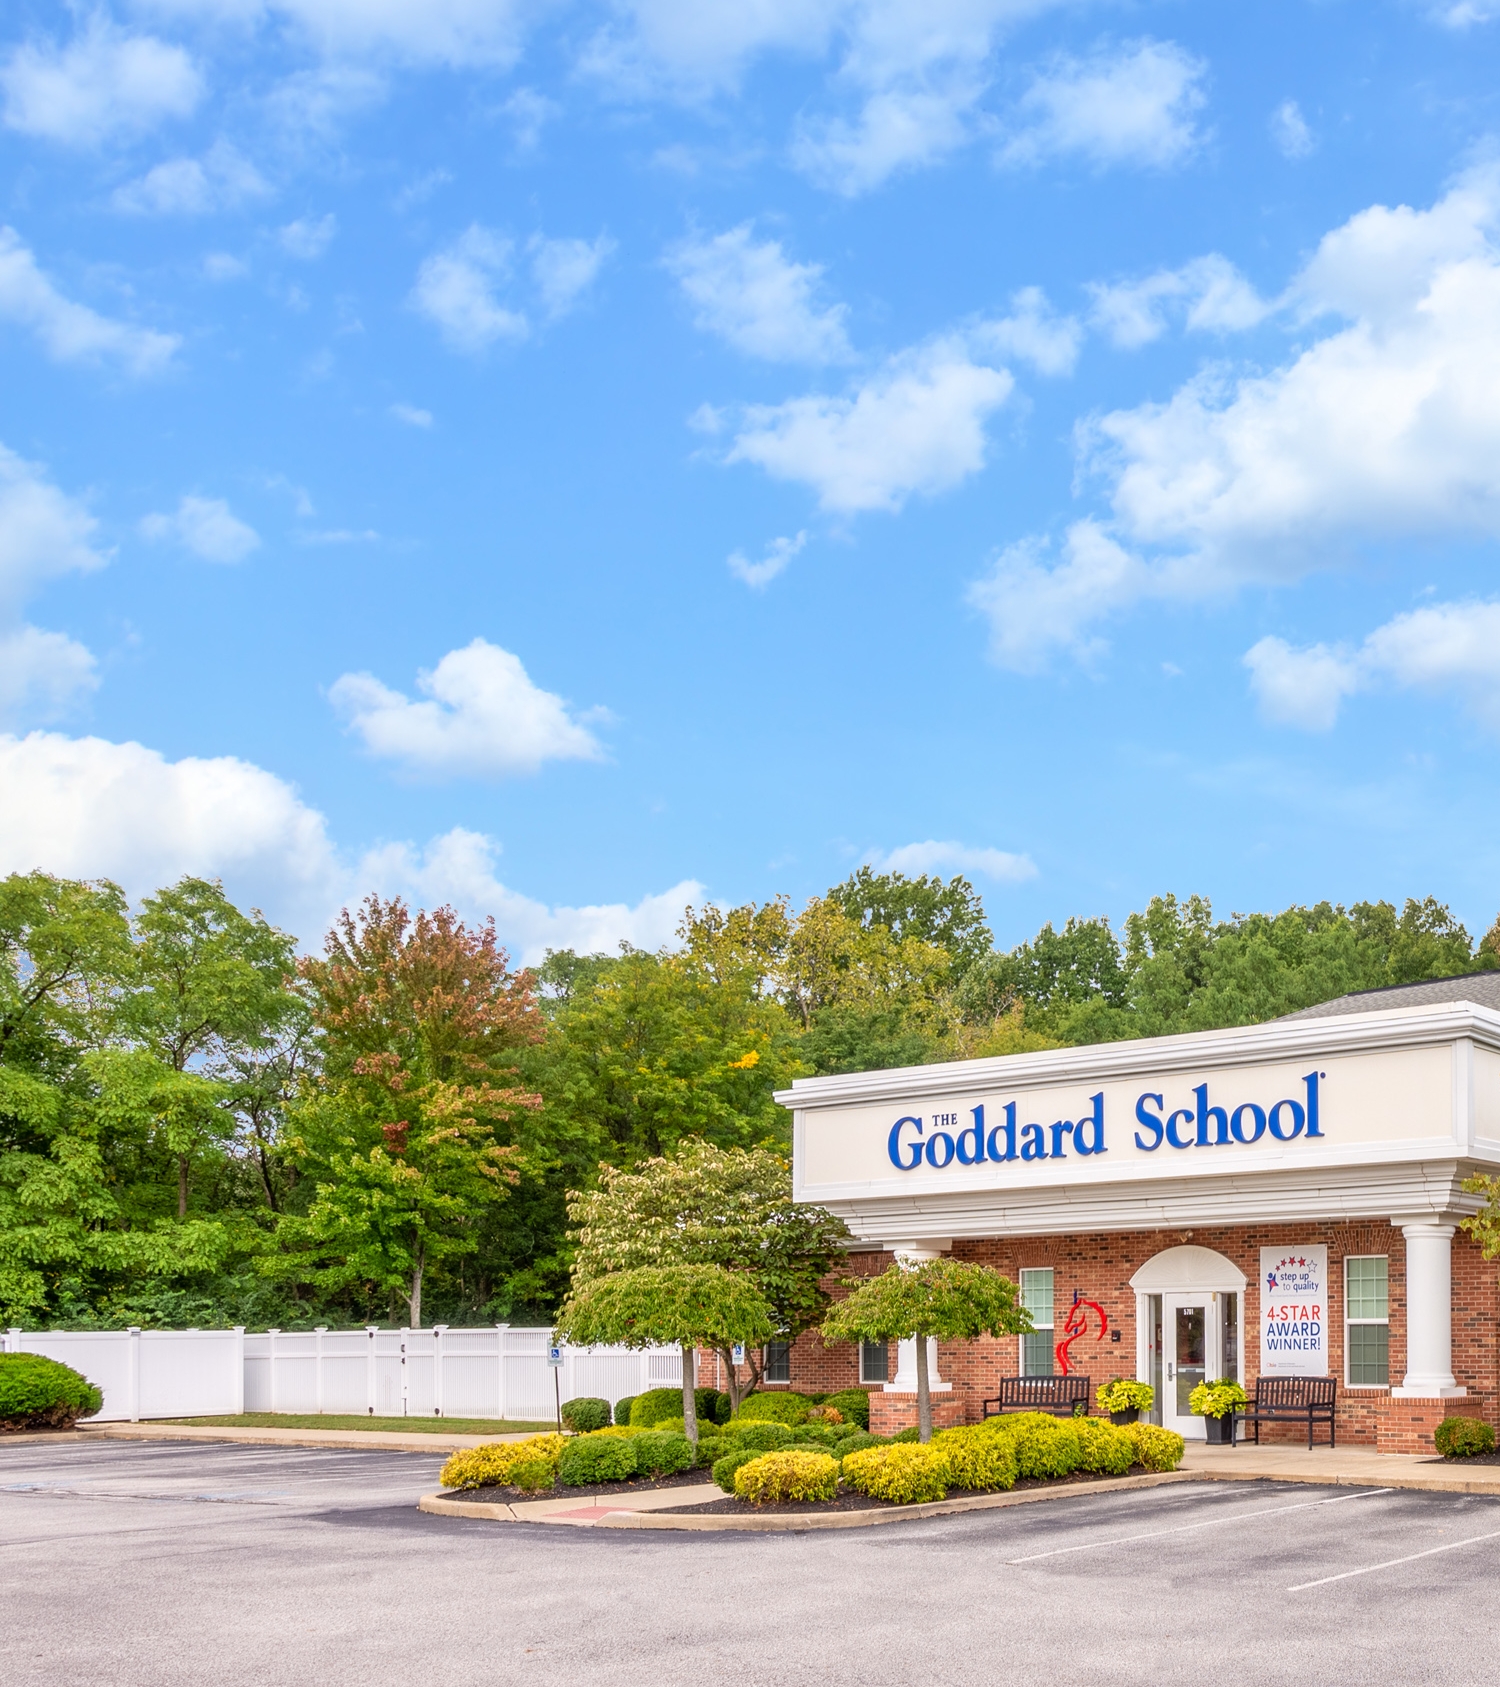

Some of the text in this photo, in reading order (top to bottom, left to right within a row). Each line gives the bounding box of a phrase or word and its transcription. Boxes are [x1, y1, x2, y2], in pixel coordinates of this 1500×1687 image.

[887, 1071, 1325, 1171] Goddard School
[932, 1113, 958, 1126] THE
[1280, 1272, 1309, 1283] step up
[1283, 1280, 1319, 1292] to quality
[1267, 1305, 1320, 1321] 4-STAR
[1267, 1322, 1321, 1336] AWARD
[1267, 1337, 1321, 1350] WINNER!
